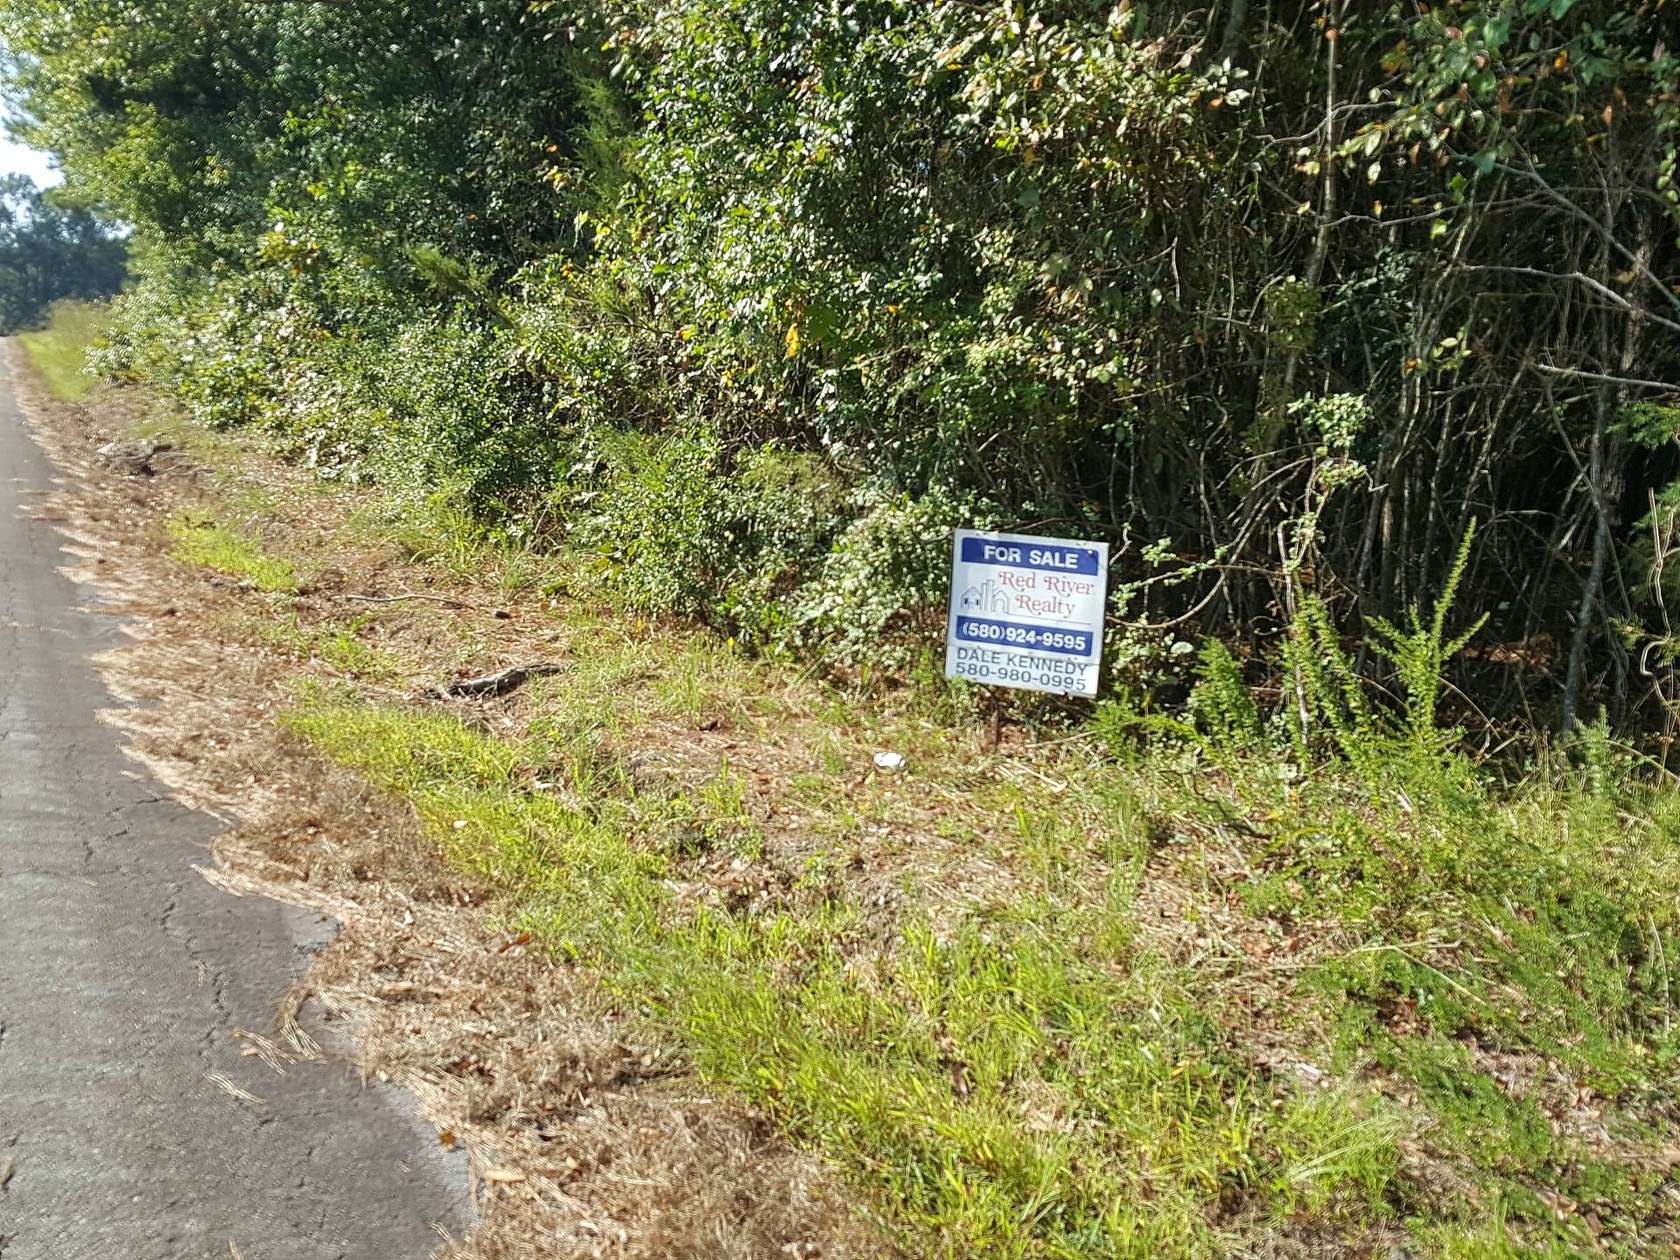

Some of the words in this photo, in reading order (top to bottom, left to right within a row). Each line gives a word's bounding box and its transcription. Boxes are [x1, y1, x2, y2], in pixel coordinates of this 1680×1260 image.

[984, 545, 1021, 562] FOR
[1029, 550, 1079, 568] SALE
[999, 571, 1036, 592] Red
[1044, 575, 1095, 598] River
[1015, 594, 1076, 619] Realty
[957, 647, 1001, 665] DALE
[1007, 653, 1088, 676] KENNEDY
[955, 663, 1086, 691] 580-980-0995
